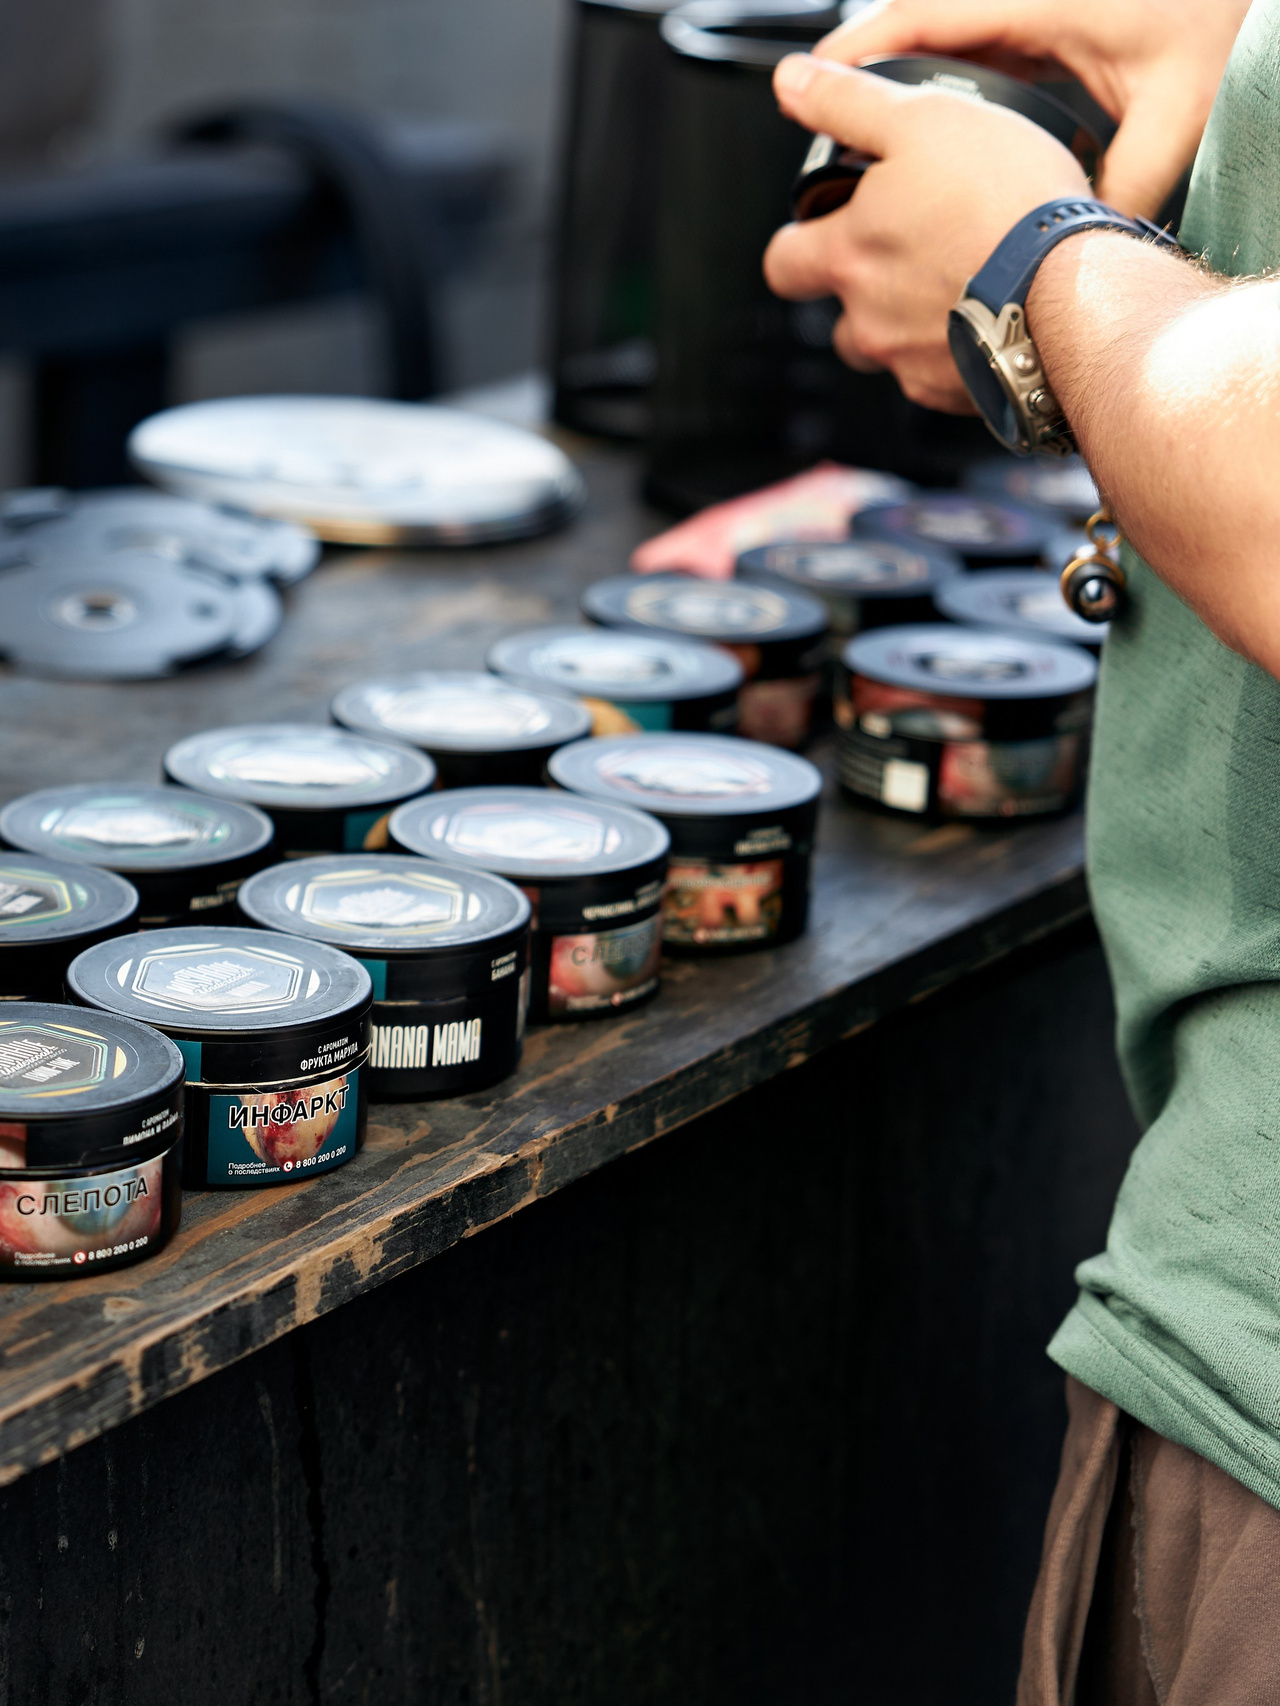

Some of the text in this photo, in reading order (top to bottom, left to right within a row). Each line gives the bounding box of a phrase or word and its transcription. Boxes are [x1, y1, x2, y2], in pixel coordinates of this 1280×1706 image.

[300, 1041, 359, 1071] ФРУКТА МАРУЛА
[318, 1037, 349, 1054] С АРОМАТОМ
[370, 1018, 482, 1068] ANANA MAMA
[229, 1084, 350, 1128] ИНФАРКТ
[228, 1161, 266, 1170] Подробнее
[295, 1145, 347, 1169] 8 800 200 0 200
[234, 1166, 280, 1176] последствиях
[15, 1176, 149, 1216] СЛЕПОТА
[88, 1235, 148, 1261] 8 800 200 0 200
